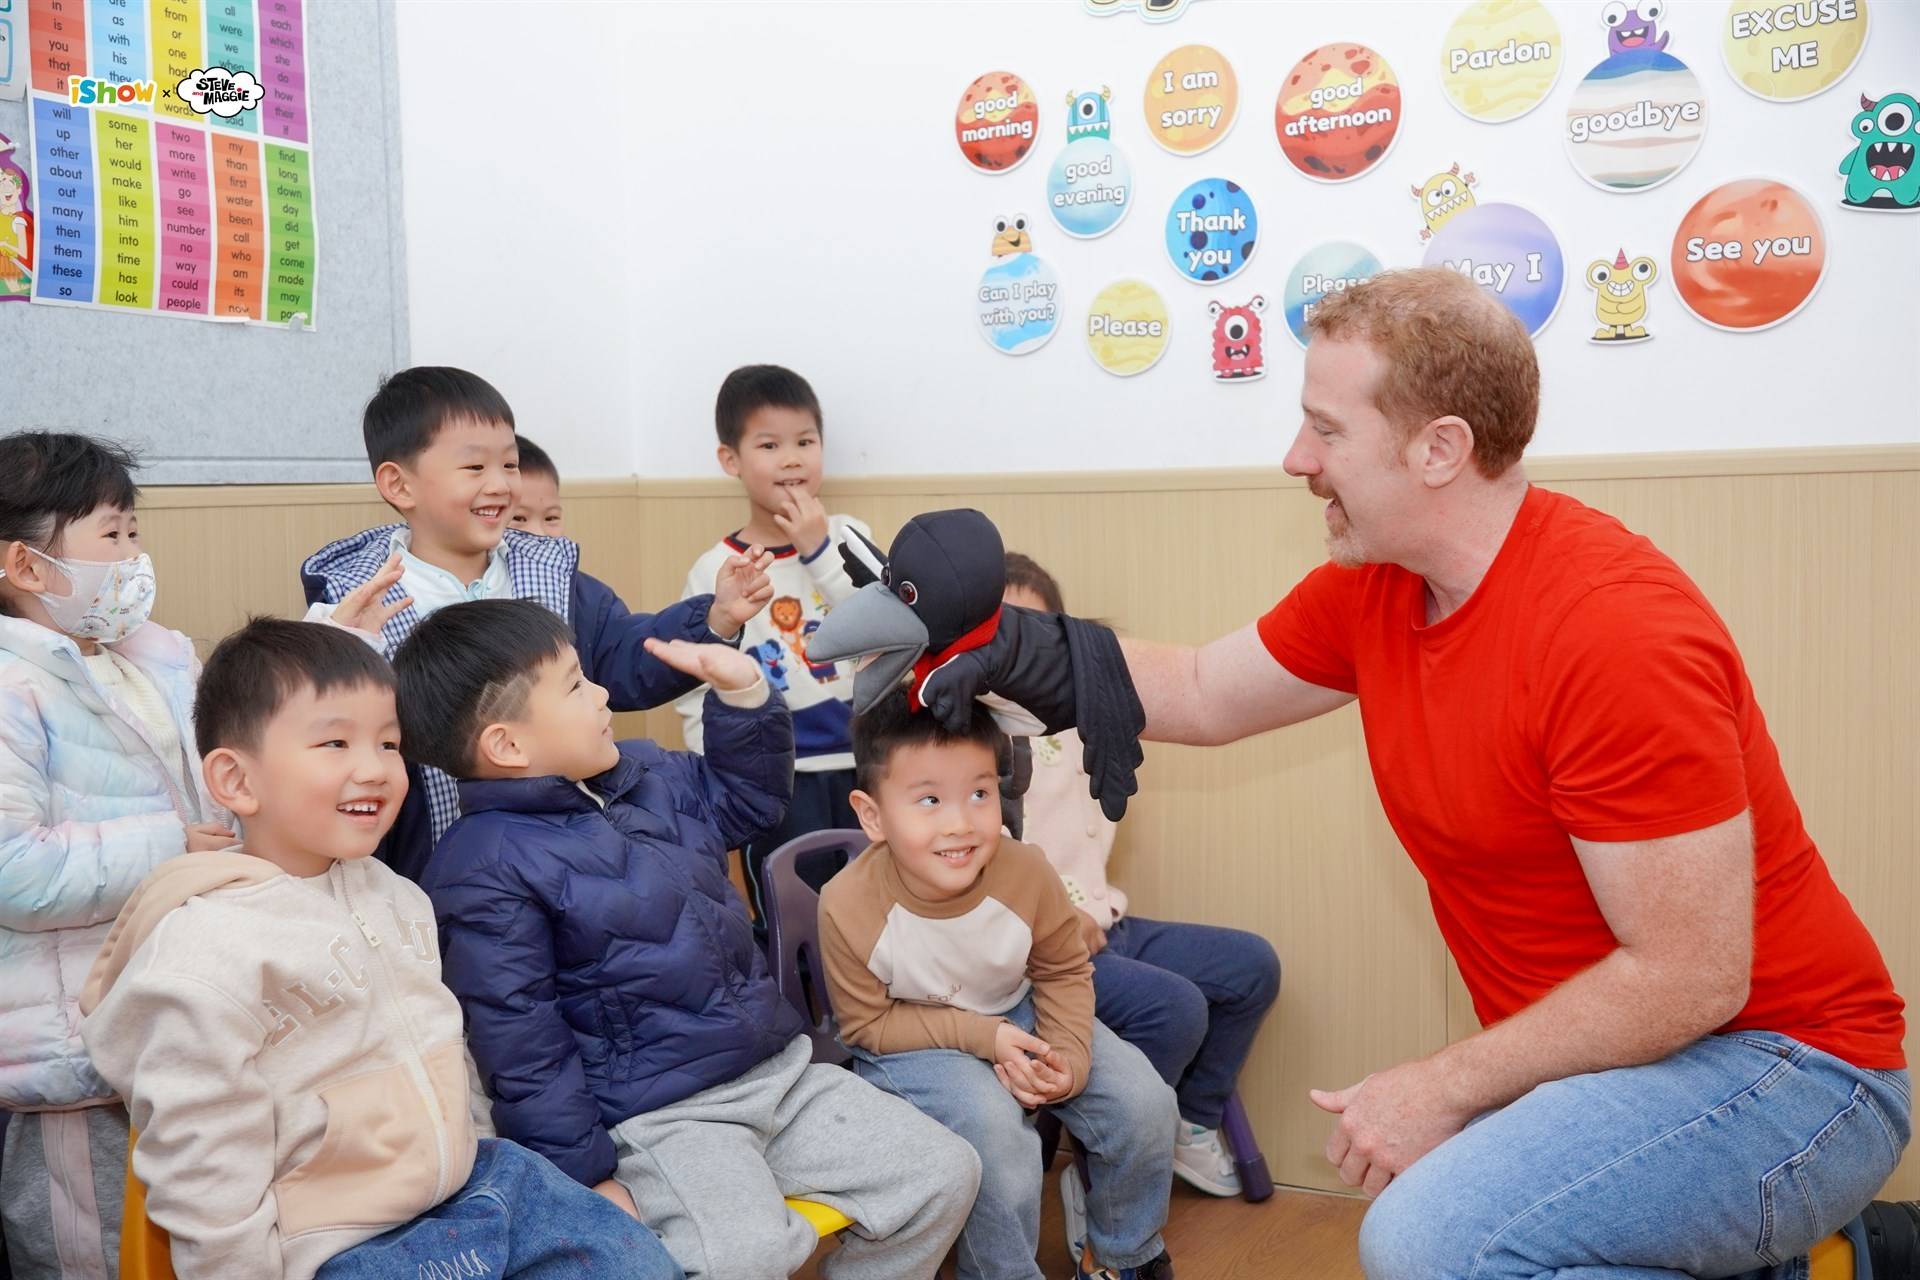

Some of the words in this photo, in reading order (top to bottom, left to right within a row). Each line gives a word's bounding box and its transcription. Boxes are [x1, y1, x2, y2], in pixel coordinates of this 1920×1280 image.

[52, 0, 62, 11] in
[224, 7, 236, 17] all
[275, 3, 286, 12] an
[112, 16, 125, 26] as
[165, 7, 187, 23] from
[1731, 0, 1858, 39] EXCUSE
[53, 18, 62, 31] is
[219, 23, 243, 36] were
[270, 18, 292, 32] each
[108, 34, 131, 47] with
[171, 30, 182, 40] or
[49, 39, 69, 53] you
[224, 43, 239, 54] we
[269, 35, 295, 49] which
[113, 52, 128, 66] his
[168, 48, 187, 60] one
[275, 54, 290, 66] she
[1450, 39, 1551, 73] Pardon
[1771, 41, 1819, 72] ME
[48, 58, 71, 73] that
[169, 64, 188, 78] had
[57, 78, 64, 90] it
[277, 72, 288, 83] do
[1163, 71, 1174, 93] I
[1182, 69, 1218, 91] am
[275, 89, 293, 102] how
[1310, 77, 1363, 109] good
[974, 90, 1018, 120] good
[52, 108, 72, 120] will
[1160, 105, 1222, 129] sorry
[1284, 104, 1392, 137] afternoon
[108, 119, 138, 133] some
[1570, 100, 1701, 142] goodbye
[56, 129, 71, 142] up
[171, 130, 191, 143] two
[961, 118, 1034, 144] morning
[115, 138, 133, 150] her
[228, 142, 244, 155] my
[50, 146, 80, 160] other
[169, 150, 196, 162] more
[279, 150, 296, 163] find
[109, 157, 142, 171] would
[226, 157, 248, 171] than
[1066, 155, 1112, 184] good
[50, 165, 82, 180] about
[171, 166, 197, 181] write
[278, 168, 298, 183] long
[112, 175, 142, 190] make
[229, 175, 248, 188] first
[58, 187, 76, 198] out
[178, 188, 191, 200] go
[277, 185, 302, 199] down
[1053, 183, 1125, 208] evening
[118, 196, 137, 209] like
[226, 195, 253, 207] water
[52, 206, 84, 221] many
[177, 205, 194, 217] see
[282, 204, 299, 216] day
[118, 214, 138, 228] him
[228, 213, 253, 226] been
[1177, 208, 1246, 233] Thank
[56, 225, 81, 239] then
[166, 221, 206, 236] number
[285, 221, 299, 232] did
[119, 234, 139, 247] into
[233, 232, 250, 243] call
[54, 244, 82, 258] them
[180, 243, 193, 253] no
[285, 240, 300, 251] get
[1686, 236, 1742, 262] See
[1753, 234, 1812, 265] you
[117, 252, 141, 266] time
[231, 250, 252, 262] who
[280, 257, 305, 268] come
[1189, 244, 1232, 272] you
[52, 263, 82, 278] these
[175, 262, 197, 274] way
[232, 269, 248, 279] am
[1526, 252, 1542, 283] I
[118, 272, 138, 285] has
[171, 278, 198, 291] could
[278, 275, 304, 286] made
[59, 286, 72, 296] so
[115, 290, 138, 304] look
[234, 286, 245, 297] its
[978, 285, 1008, 303] Can
[1013, 281, 1021, 300] I
[1023, 279, 1057, 305] play
[166, 297, 201, 310] people
[280, 292, 300, 305] may
[980, 308, 1015, 327] with
[1018, 302, 1057, 327] you?
[1088, 314, 1162, 339] Please
